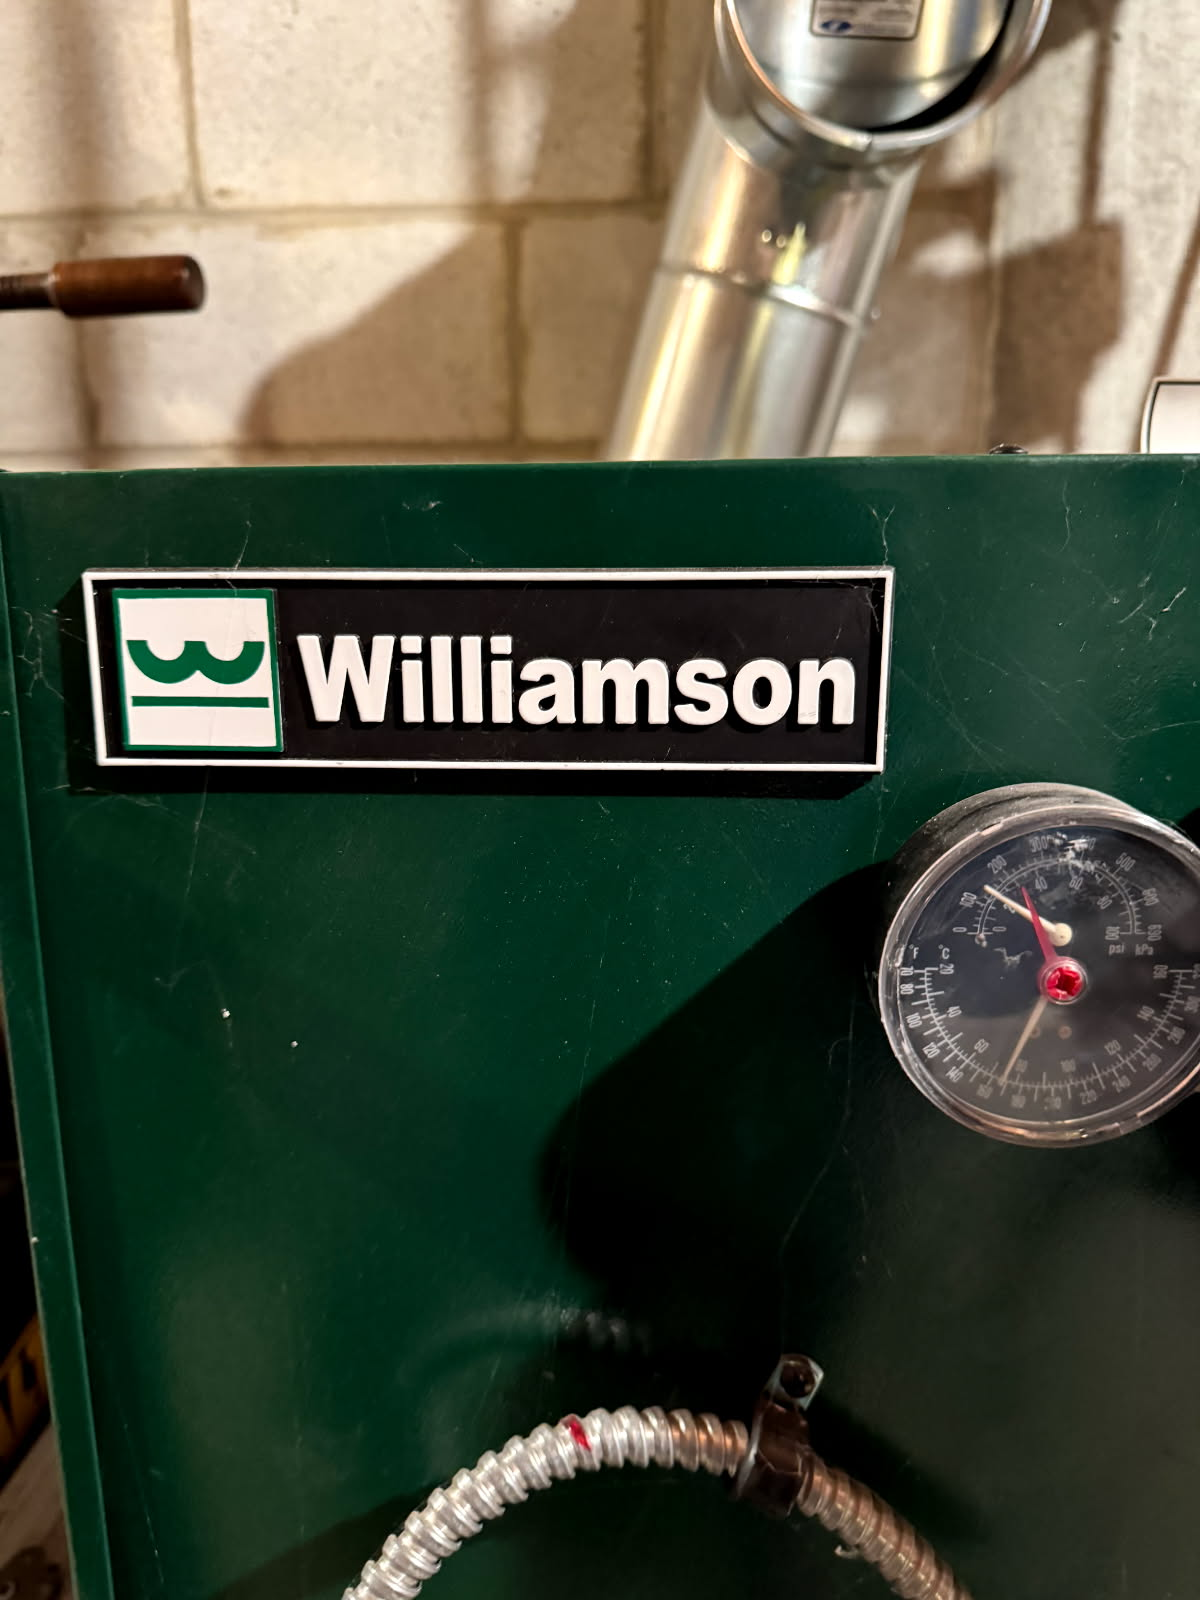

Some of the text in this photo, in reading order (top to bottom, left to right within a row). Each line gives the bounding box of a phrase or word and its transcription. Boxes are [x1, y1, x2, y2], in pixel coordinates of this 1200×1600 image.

[296, 634, 857, 726] Williamson
[1030, 836, 1048, 853] 300
[987, 854, 1007, 874] 200
[1115, 852, 1136, 871] 500
[1034, 876, 1048, 891] 40
[1069, 876, 1083, 890] 60
[960, 892, 977, 908] 100
[1097, 895, 1113, 910] 80
[1142, 888, 1160, 906] 600
[1105, 926, 1120, 941] 100
[1108, 942, 1125, 956] psi
[1135, 943, 1154, 956] kPa
[900, 966, 914, 976] 70
[939, 963, 955, 975] 20
[900, 983, 915, 995] 80
[946, 1005, 962, 1018] 40
[905, 1012, 923, 1029] 100
[922, 1041, 941, 1059] 120
[974, 1038, 990, 1053] 60
[1104, 1039, 1121, 1056] 120
[945, 1066, 964, 1083] 140
